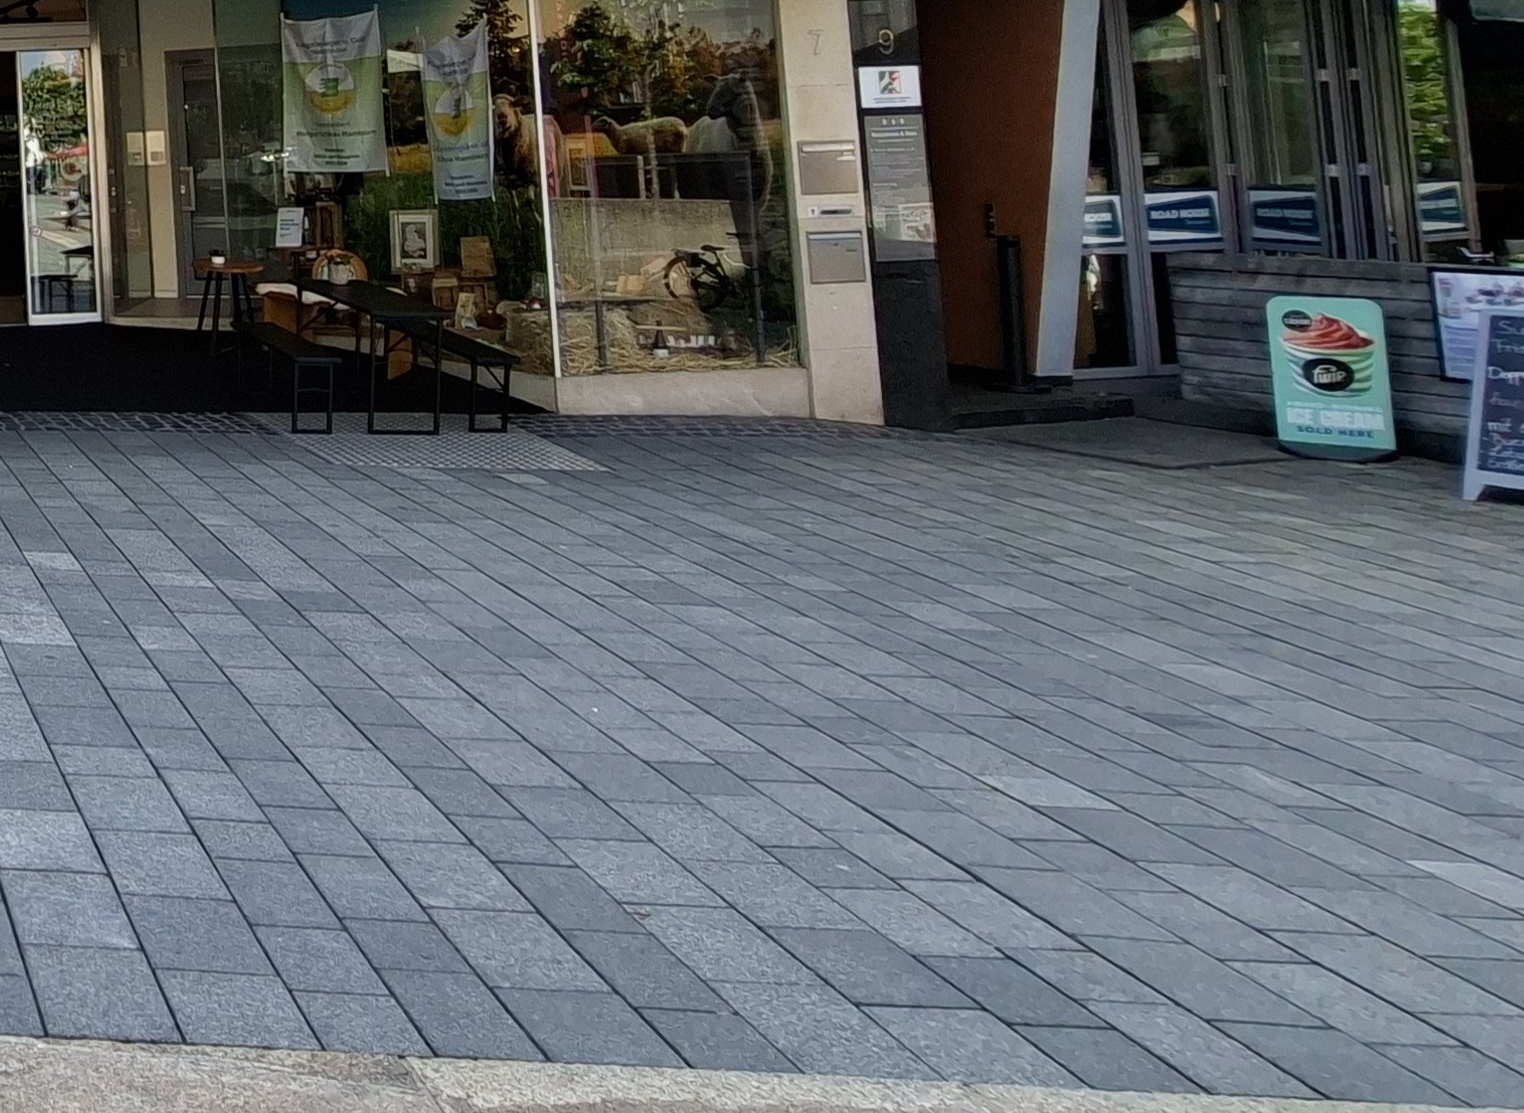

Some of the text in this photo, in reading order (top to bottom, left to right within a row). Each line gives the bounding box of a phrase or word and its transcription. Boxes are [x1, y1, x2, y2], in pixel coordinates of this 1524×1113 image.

[878, 28, 895, 56] 9
[1287, 407, 1315, 425] ICE
[1320, 410, 1386, 432] CREAM
[1297, 425, 1375, 439] SOLD HERE
